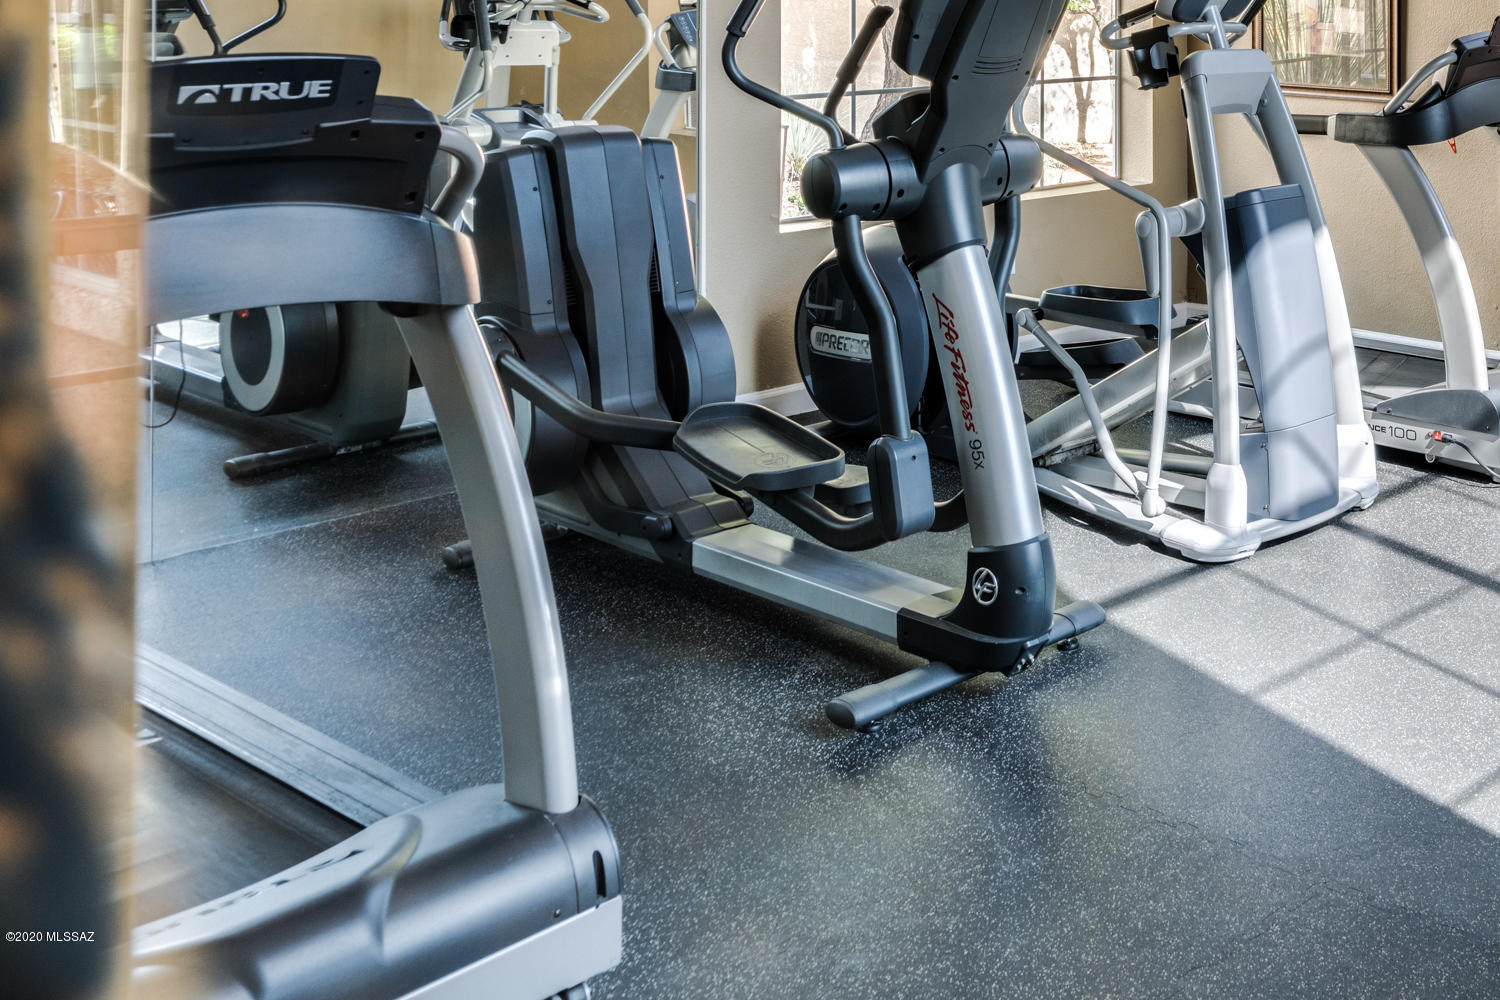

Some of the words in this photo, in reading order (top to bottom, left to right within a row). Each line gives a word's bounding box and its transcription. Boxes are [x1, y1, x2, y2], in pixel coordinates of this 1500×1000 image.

[222, 80, 333, 103] TRUE
[932, 293, 959, 345] Life
[944, 344, 976, 433] Fitness
[1388, 425, 1417, 441] 100
